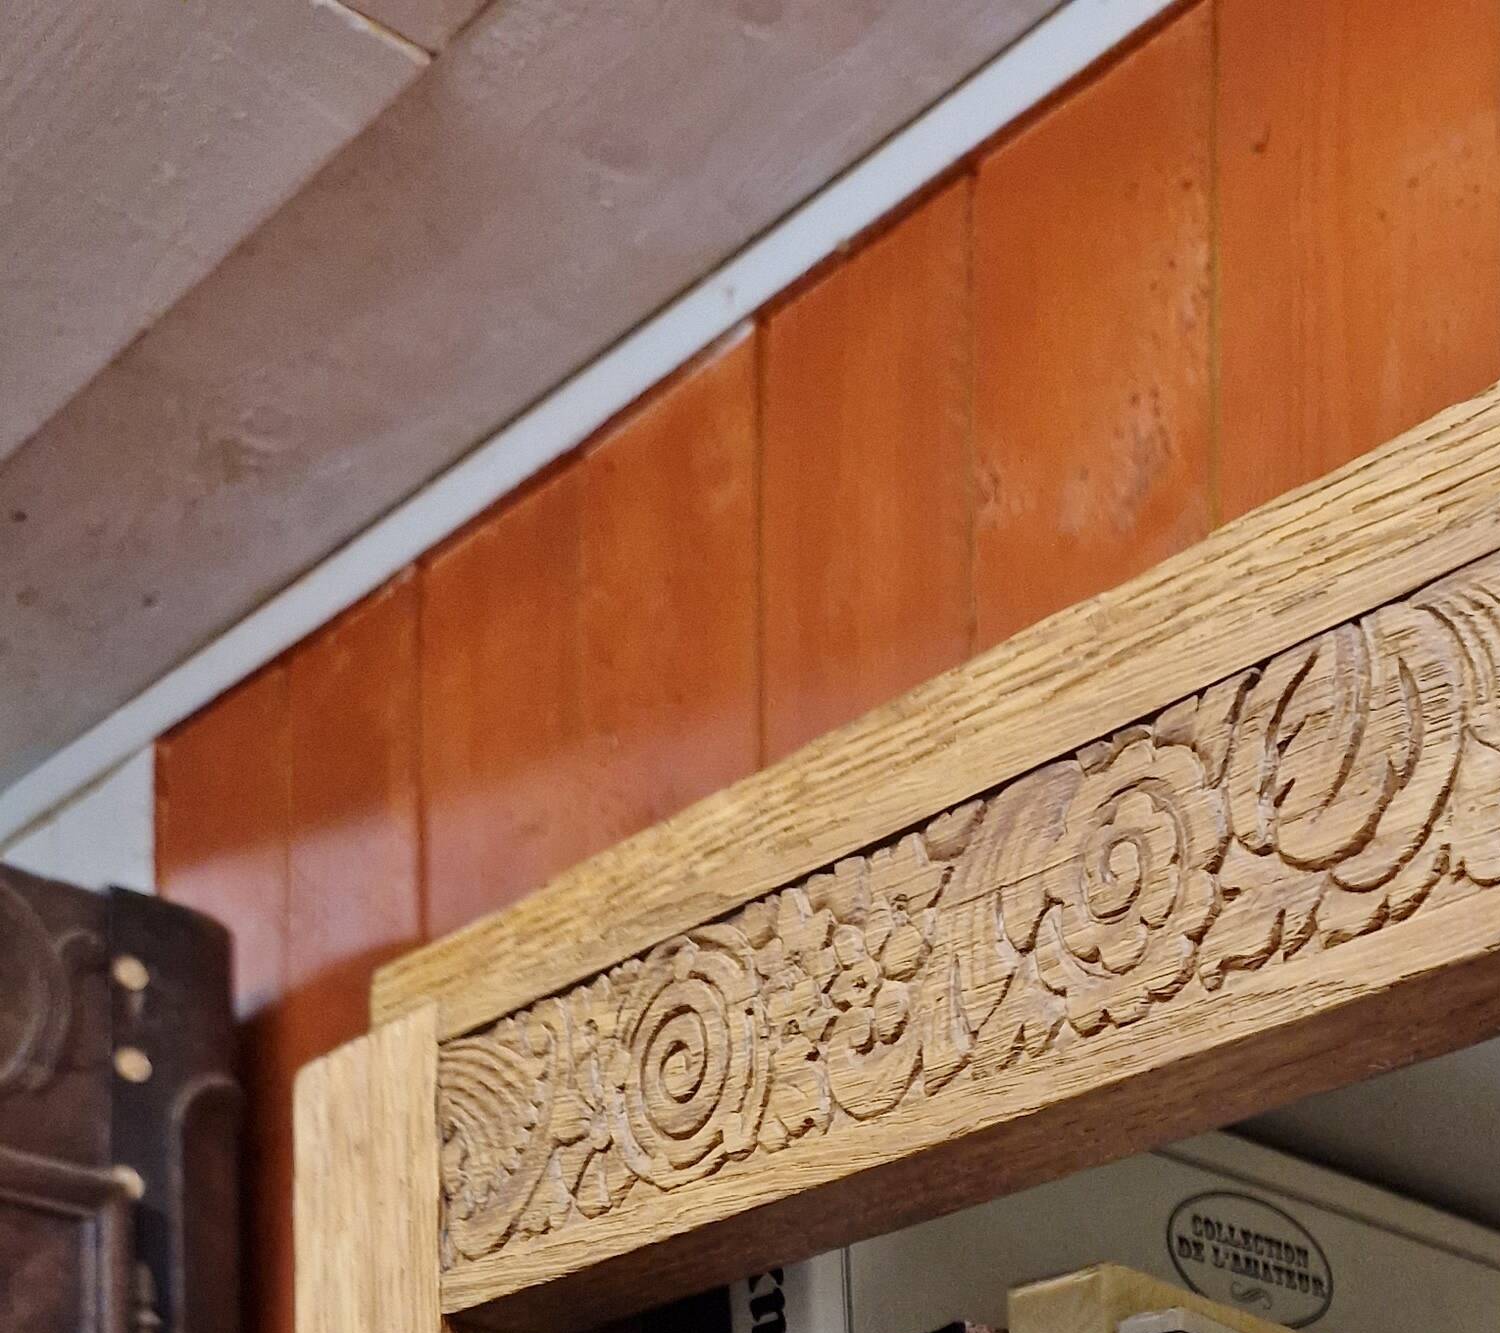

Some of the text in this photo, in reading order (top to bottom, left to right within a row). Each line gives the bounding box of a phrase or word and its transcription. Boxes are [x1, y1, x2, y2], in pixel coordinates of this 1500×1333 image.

[1177, 1235, 1327, 1298] DE L'AMATEUR
[1192, 1213, 1309, 1269] COLLECTION
